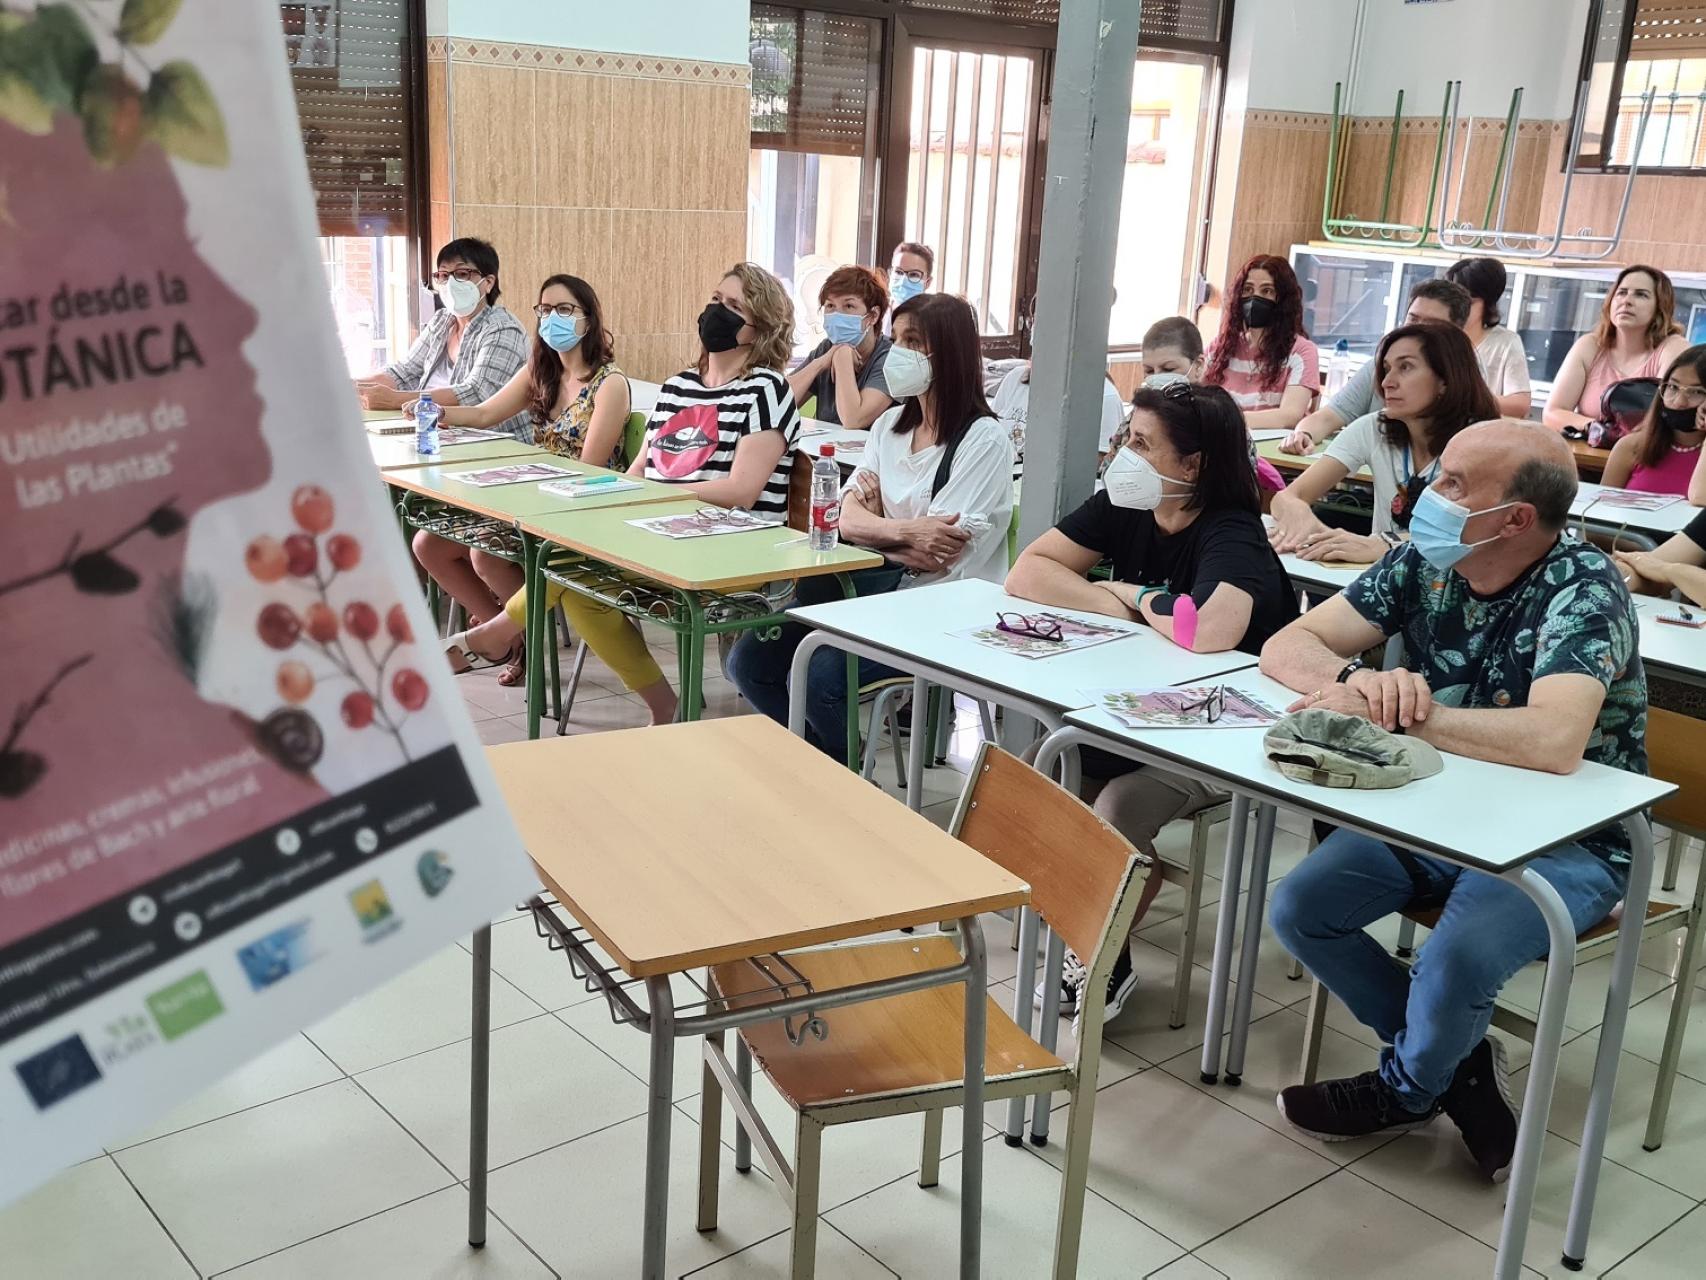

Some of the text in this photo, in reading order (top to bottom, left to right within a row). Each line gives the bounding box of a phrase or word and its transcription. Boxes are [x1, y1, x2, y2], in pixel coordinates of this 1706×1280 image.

[50, 274, 150, 321] desde
[157, 270, 188, 304] la
[151, 402, 187, 432] de
[15, 476, 62, 508] las
